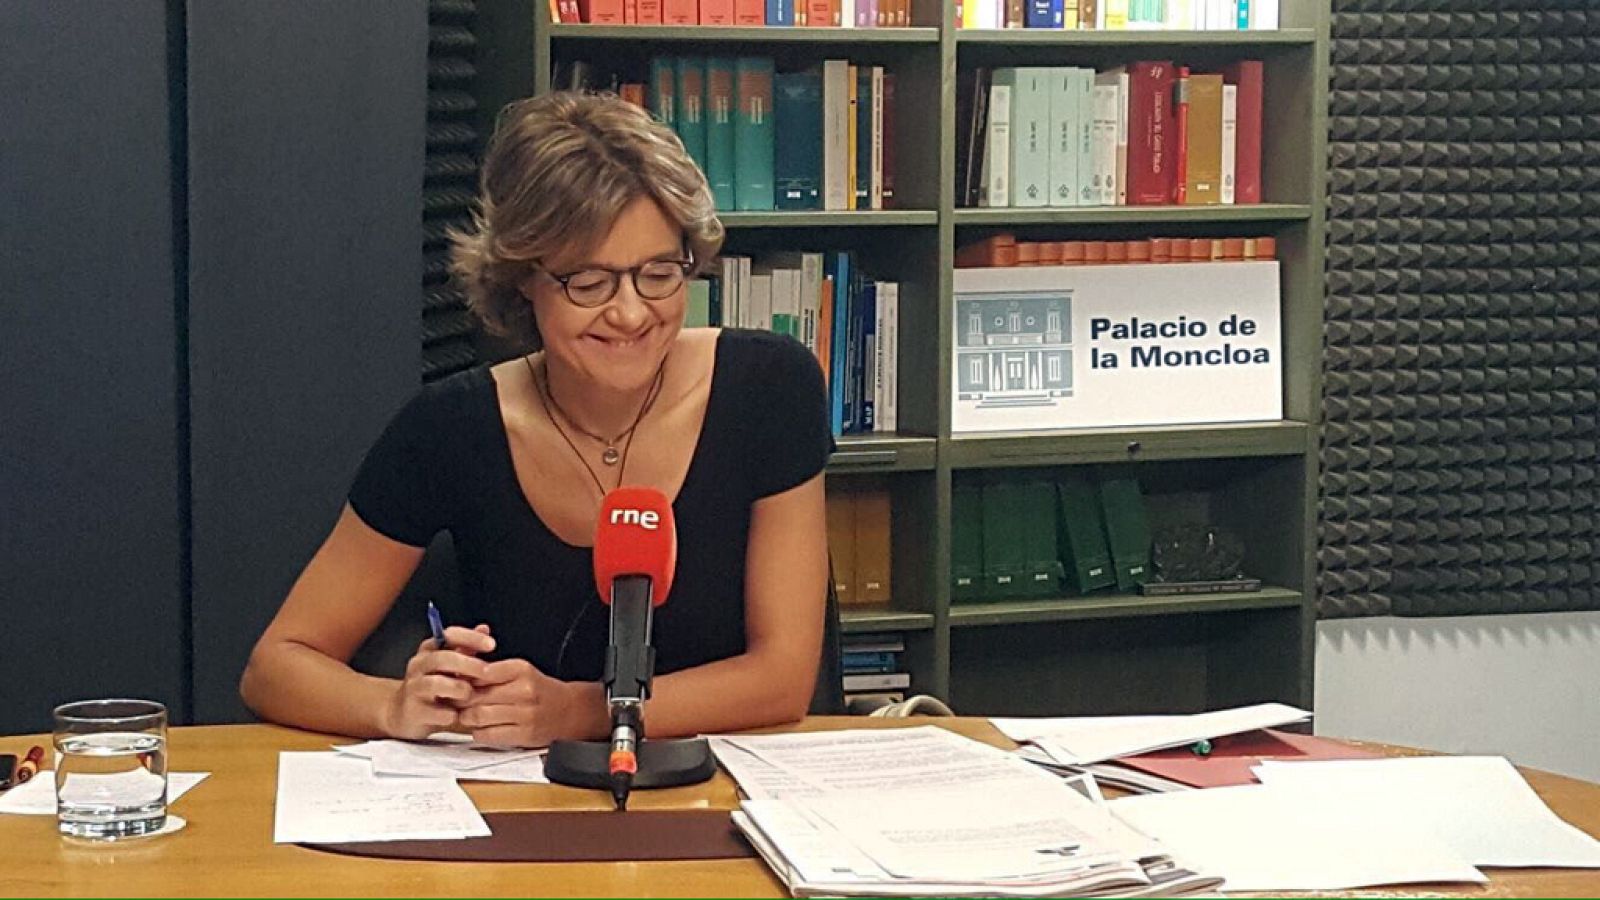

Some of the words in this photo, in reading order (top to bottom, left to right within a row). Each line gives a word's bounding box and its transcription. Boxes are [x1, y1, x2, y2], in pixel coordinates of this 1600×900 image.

[1090, 316, 1207, 340] Palacio
[1218, 314, 1257, 337] de
[1091, 347, 1118, 369] la
[1131, 343, 1270, 368] Moncloa
[610, 508, 660, 530] rne
